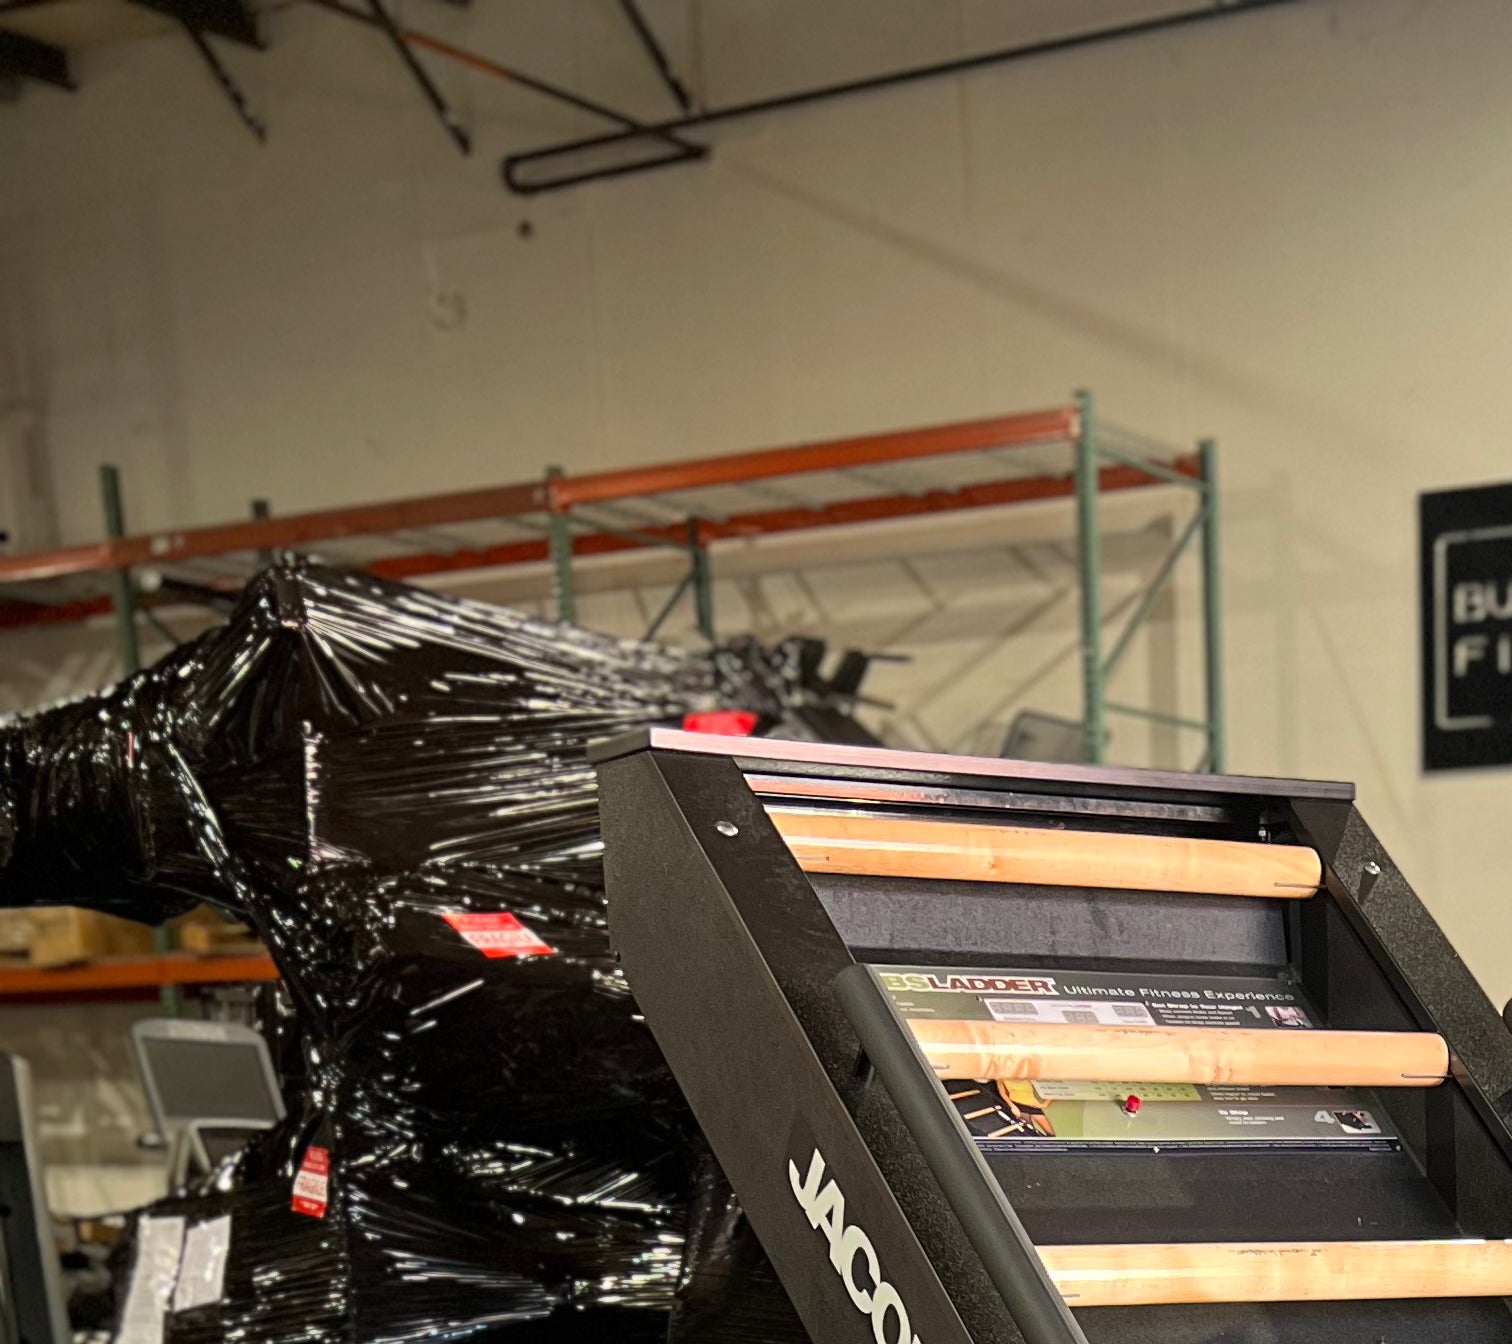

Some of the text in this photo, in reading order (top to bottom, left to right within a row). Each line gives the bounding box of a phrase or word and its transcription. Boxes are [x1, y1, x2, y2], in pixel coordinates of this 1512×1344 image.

[1063, 984, 1135, 998] Ultimate
[1138, 987, 1201, 999] Fitness
[1203, 990, 1295, 1001] Experience
[1313, 1110, 1335, 1124] 4
